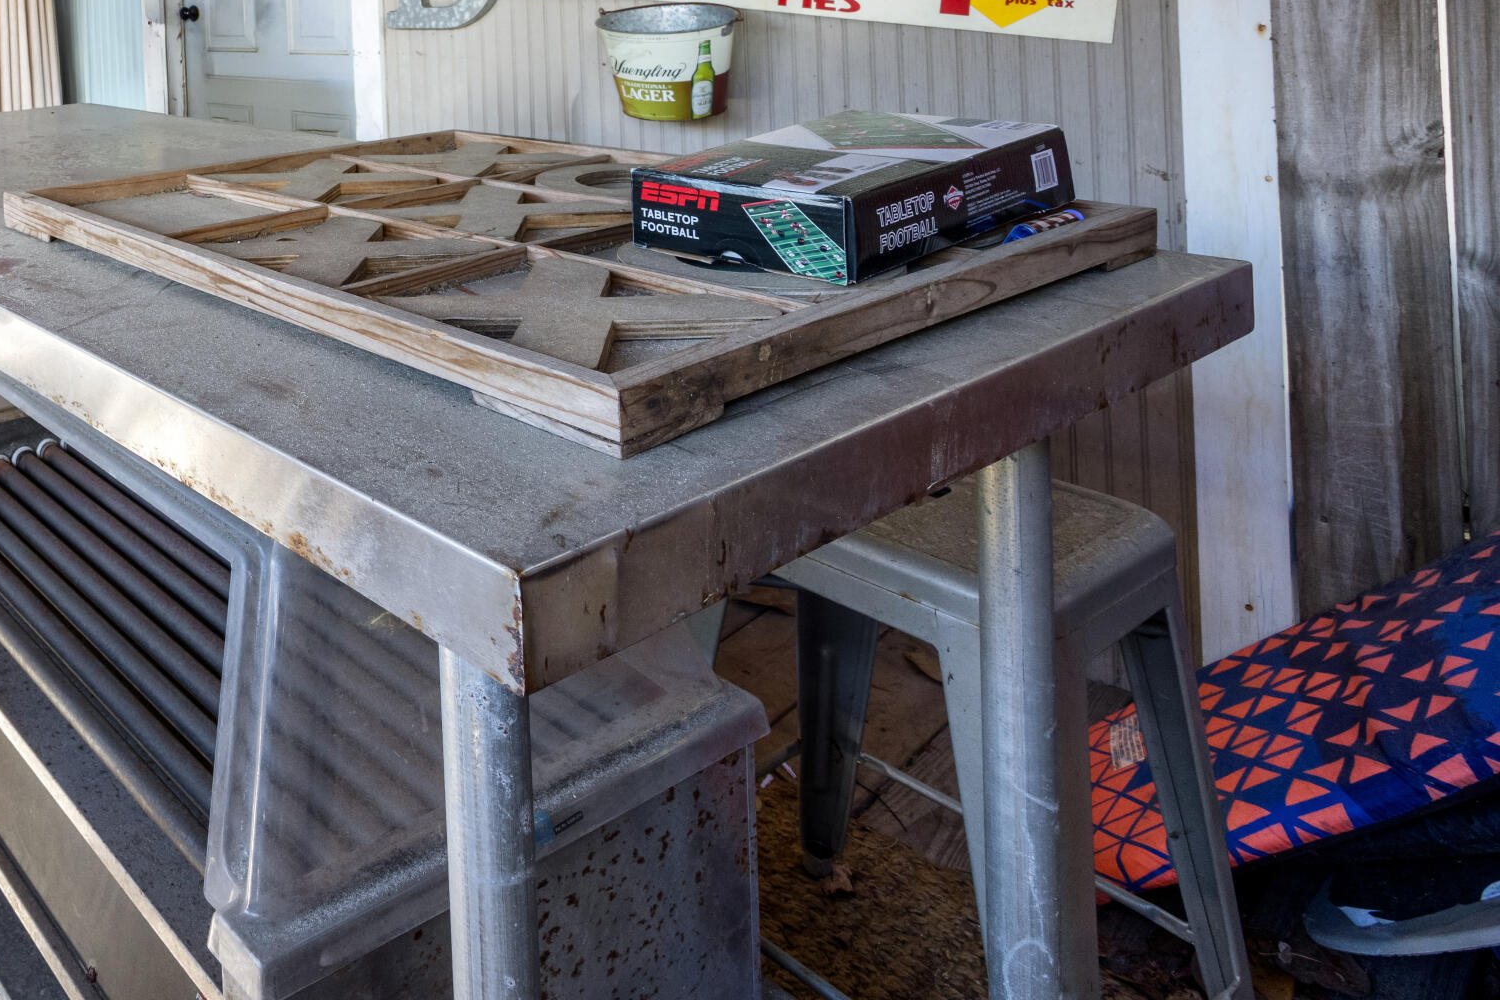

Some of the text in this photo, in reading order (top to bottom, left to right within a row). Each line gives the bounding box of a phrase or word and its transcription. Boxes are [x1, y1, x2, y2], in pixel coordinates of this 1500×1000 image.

[610, 56, 687, 81] Yuengling
[621, 85, 677, 103] LAGER
[640, 182, 720, 213] ESPN
[876, 191, 936, 228] TABLETOP
[640, 207, 700, 225] TABLETOP
[640, 220, 700, 242] FOOTBALL
[878, 216, 939, 256] FOOTBALL
